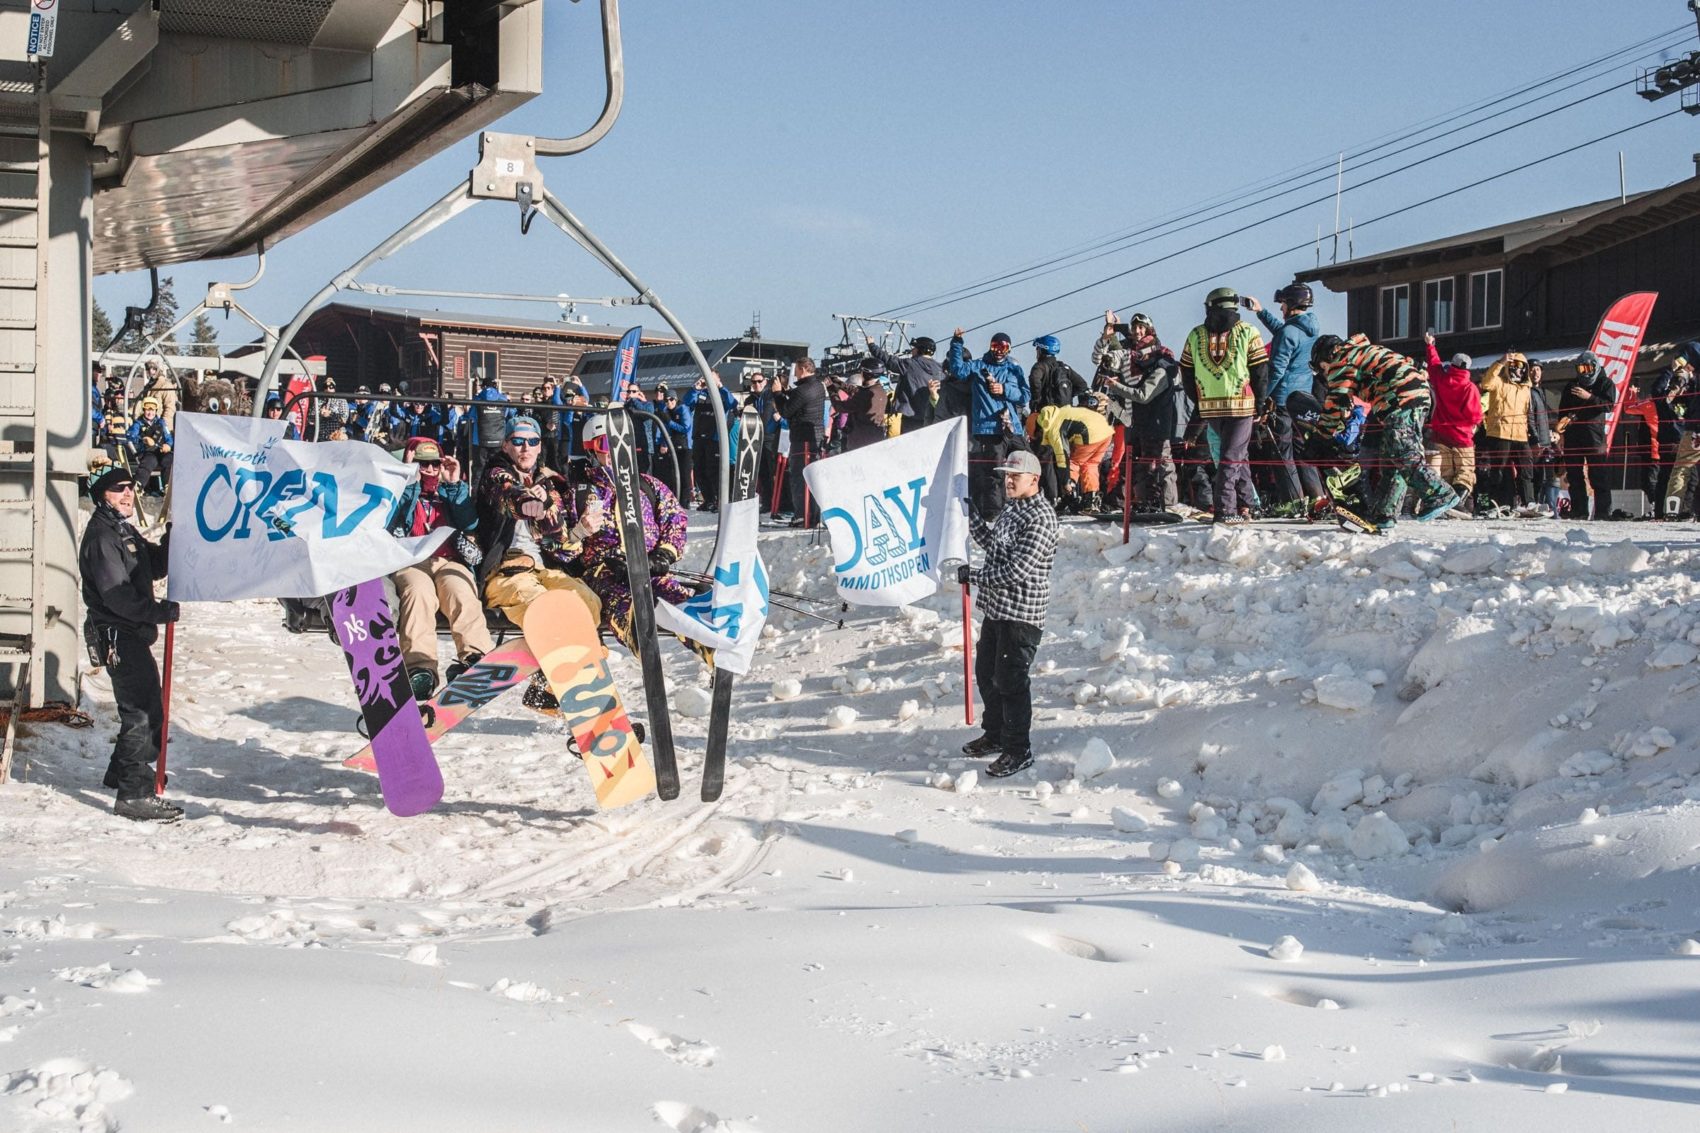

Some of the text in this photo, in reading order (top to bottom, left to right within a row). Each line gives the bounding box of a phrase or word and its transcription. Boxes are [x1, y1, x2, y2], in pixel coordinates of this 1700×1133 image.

[30, 15, 39, 52] NOTICE
[507, 162, 514, 173] 8
[1595, 319, 1641, 385] SKI
[200, 441, 267, 465] Mammoth
[821, 476, 927, 573] DAY
[836, 552, 931, 591] MMOTHSOPEN
